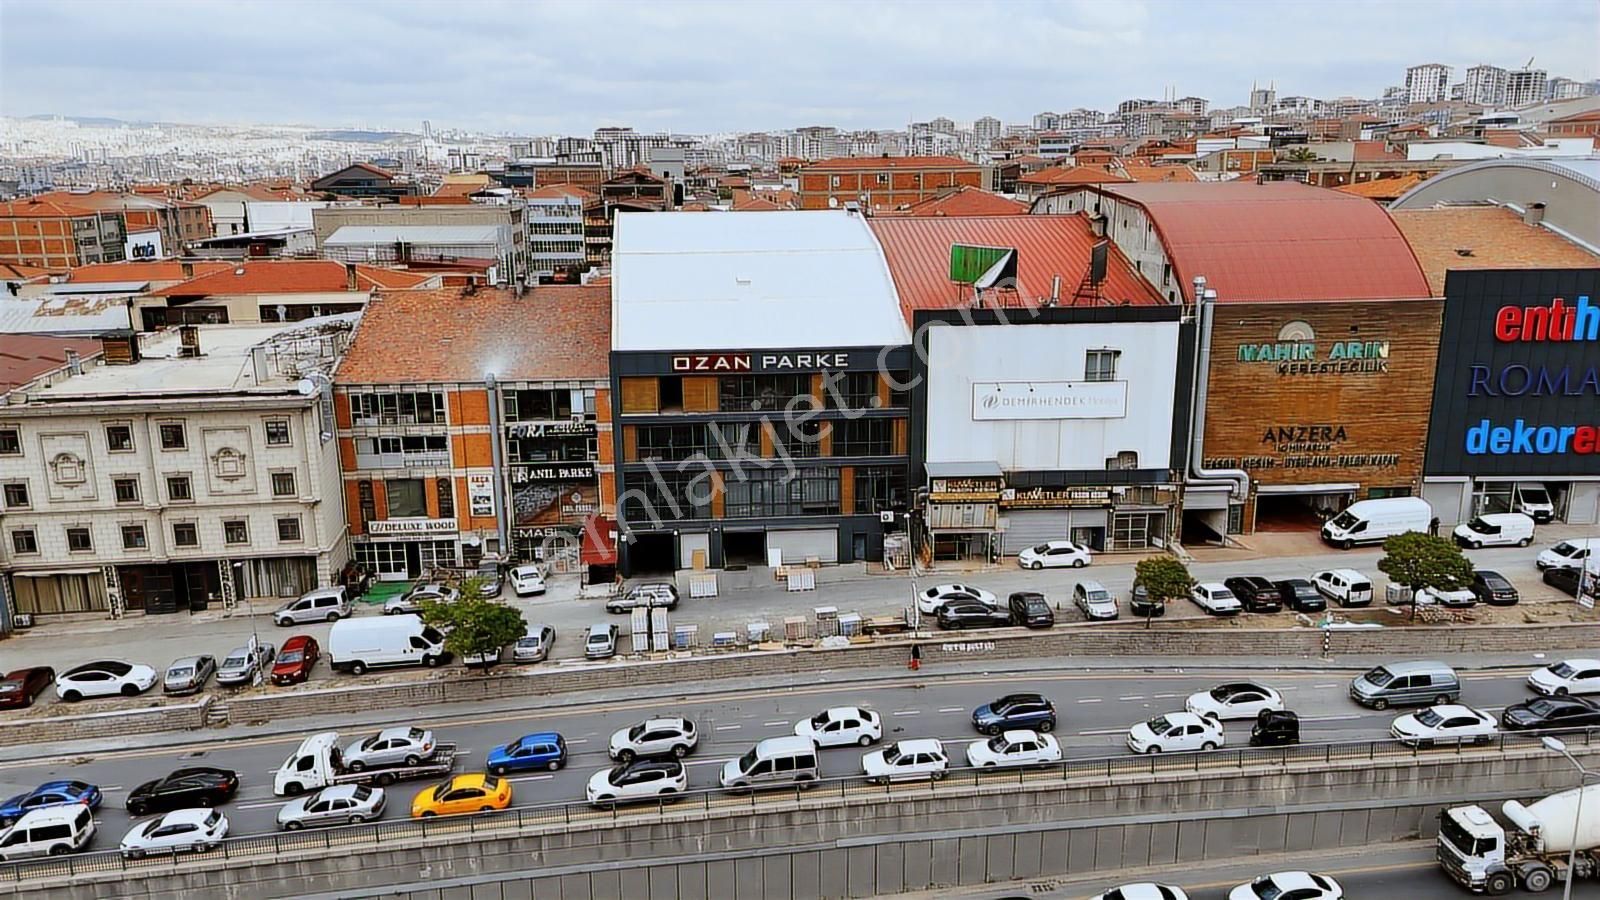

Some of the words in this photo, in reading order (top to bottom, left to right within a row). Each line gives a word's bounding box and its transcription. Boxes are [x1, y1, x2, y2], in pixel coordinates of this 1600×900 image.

[1329, 342, 1390, 359] ARIN
[673, 356, 750, 370] OZAN
[763, 353, 848, 369] PARKE
[1263, 426, 1347, 442] ANZERA
[1466, 419, 1600, 454] dekore
[529, 469, 556, 479] ANIL
[559, 467, 592, 478] PARKE
[384, 523, 422, 531] DELUXE
